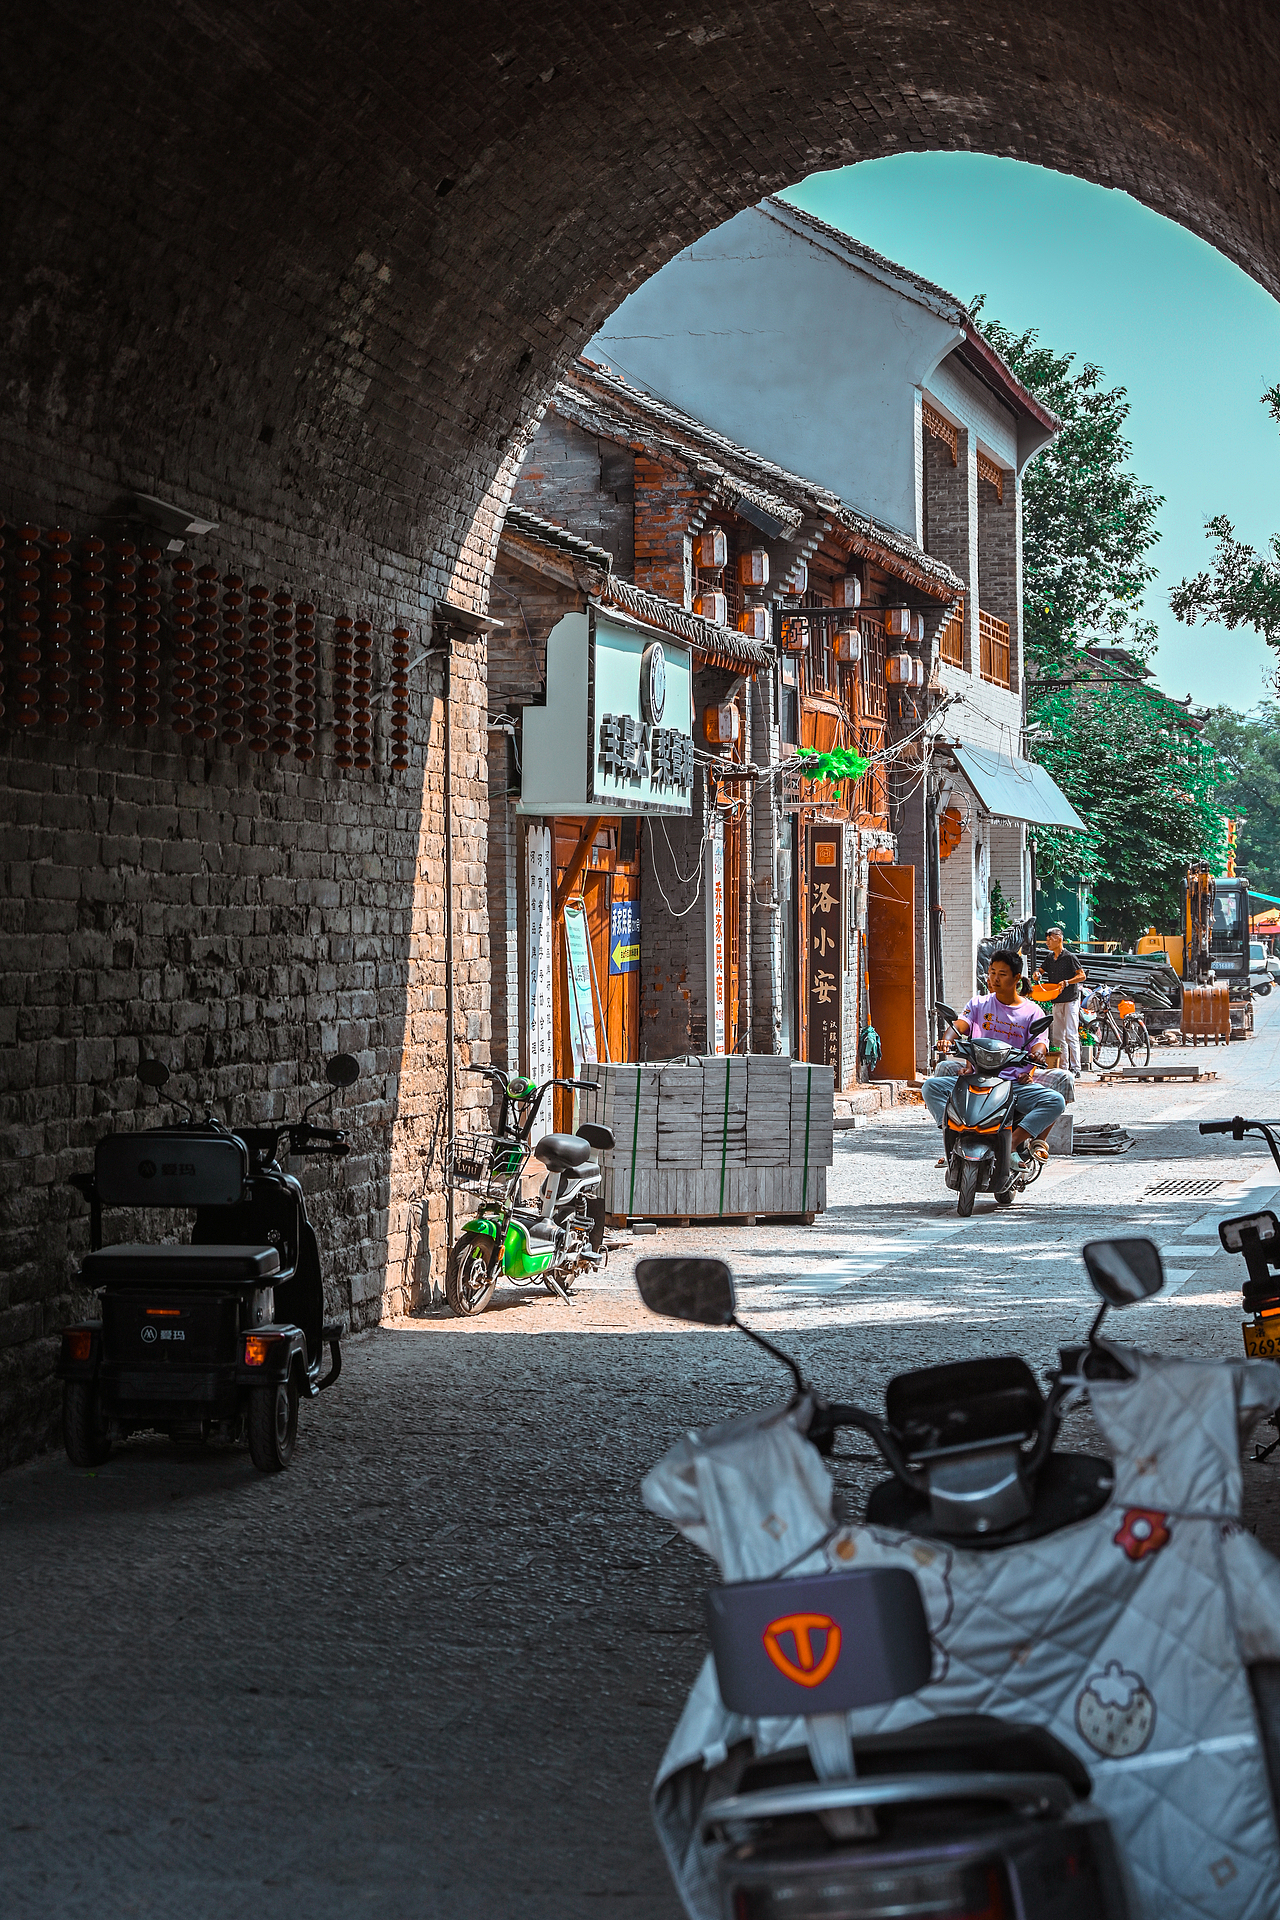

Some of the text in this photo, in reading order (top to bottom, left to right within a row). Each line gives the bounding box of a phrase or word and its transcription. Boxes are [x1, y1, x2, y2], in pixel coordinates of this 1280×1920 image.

[714, 881, 724, 1005] 乔家民宿
[811, 882, 840, 1004] 洛小安
[161, 1163, 196, 1176] 爱玛
[160, 1330, 185, 1341] 爱玛
